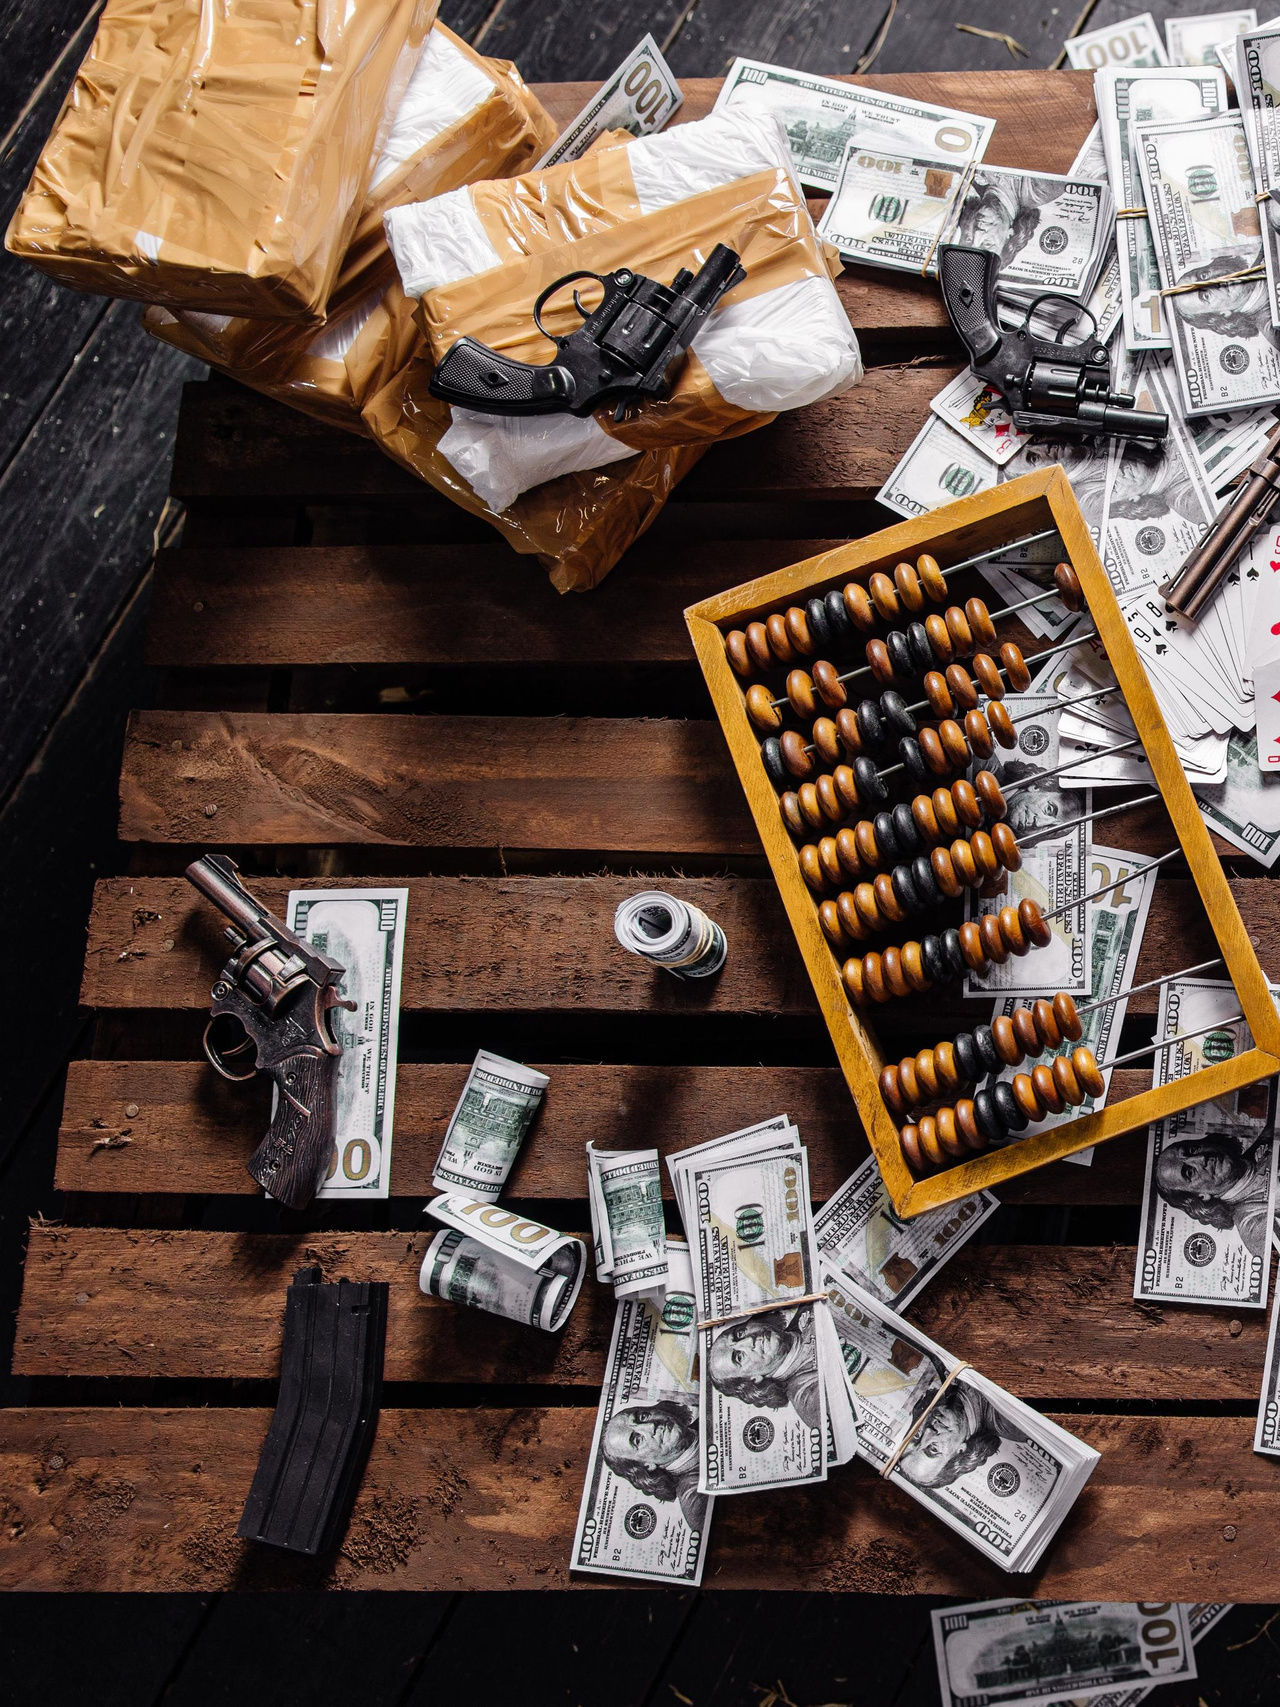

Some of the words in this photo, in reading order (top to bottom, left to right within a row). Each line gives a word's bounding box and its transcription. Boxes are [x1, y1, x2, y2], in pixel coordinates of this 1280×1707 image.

[737, 66, 769, 86] 100
[1246, 48, 1263, 92] 100
[615, 58, 669, 125] 100
[821, 98, 833, 106] IN
[832, 101, 849, 110] GOD
[1111, 80, 1133, 121] 100
[1201, 81, 1217, 108] 100
[860, 108, 876, 117] WE
[876, 113, 901, 123] TRUST
[856, 154, 904, 174] 100
[1145, 142, 1161, 181] 100
[1232, 131, 1253, 183] 100
[1063, 182, 1097, 198] 100
[828, 232, 866, 249] 100
[1043, 274, 1077, 289] 100
[1186, 367, 1202, 404] 100
[1103, 556, 1126, 592] 100
[1139, 566, 1150, 579] B2
[1144, 599, 1164, 619] 8
[1132, 624, 1152, 645] 9
[379, 901, 396, 932] 100
[1071, 937, 1083, 978] 100
[383, 966, 392, 987] THE
[368, 1000, 375, 1011] IN
[381, 986, 391, 1022] UNITED
[1164, 993, 1181, 1036] 100
[365, 1047, 372, 1062] WE
[378, 1021, 389, 1059] STATES
[363, 1063, 371, 1094] TRUST
[378, 1059, 386, 1073] OF
[375, 1071, 386, 1116] AMERICA
[485, 1073, 532, 1094] HUNDRED
[472, 1163, 493, 1174] GOD
[493, 1168, 502, 1177] IN
[695, 1181, 712, 1225] 100
[781, 1165, 801, 1221] 100
[456, 1197, 552, 1249] 100
[929, 1198, 981, 1249] 100
[1161, 1201, 1169, 1222] NOTE
[1157, 1221, 1167, 1254] RESERVE
[1141, 1247, 1158, 1290] 100
[1154, 1253, 1164, 1287] FEDERAL
[1174, 1275, 1184, 1289] B2
[1247, 1254, 1263, 1300] 100
[716, 1392, 725, 1414] NOTE
[716, 1414, 727, 1450] RESERVE
[1261, 1399, 1280, 1444] 100
[808, 1425, 824, 1469] 100
[1021, 1435, 1060, 1467] 100
[705, 1442, 722, 1485] 100
[717, 1449, 728, 1482] FEDERAL
[737, 1464, 748, 1479] B2
[603, 1470, 614, 1491] NOTE
[942, 1484, 962, 1500] NOTE
[597, 1490, 611, 1527] RESERVE
[958, 1496, 989, 1520] RESERVE
[1012, 1507, 1028, 1522] B2
[578, 1517, 599, 1561] 100
[591, 1526, 605, 1559] FEDERAL
[971, 1518, 1013, 1553] 100
[985, 1516, 1014, 1539] FEDERAL
[611, 1546, 623, 1562] B2
[943, 1614, 968, 1630] 100
